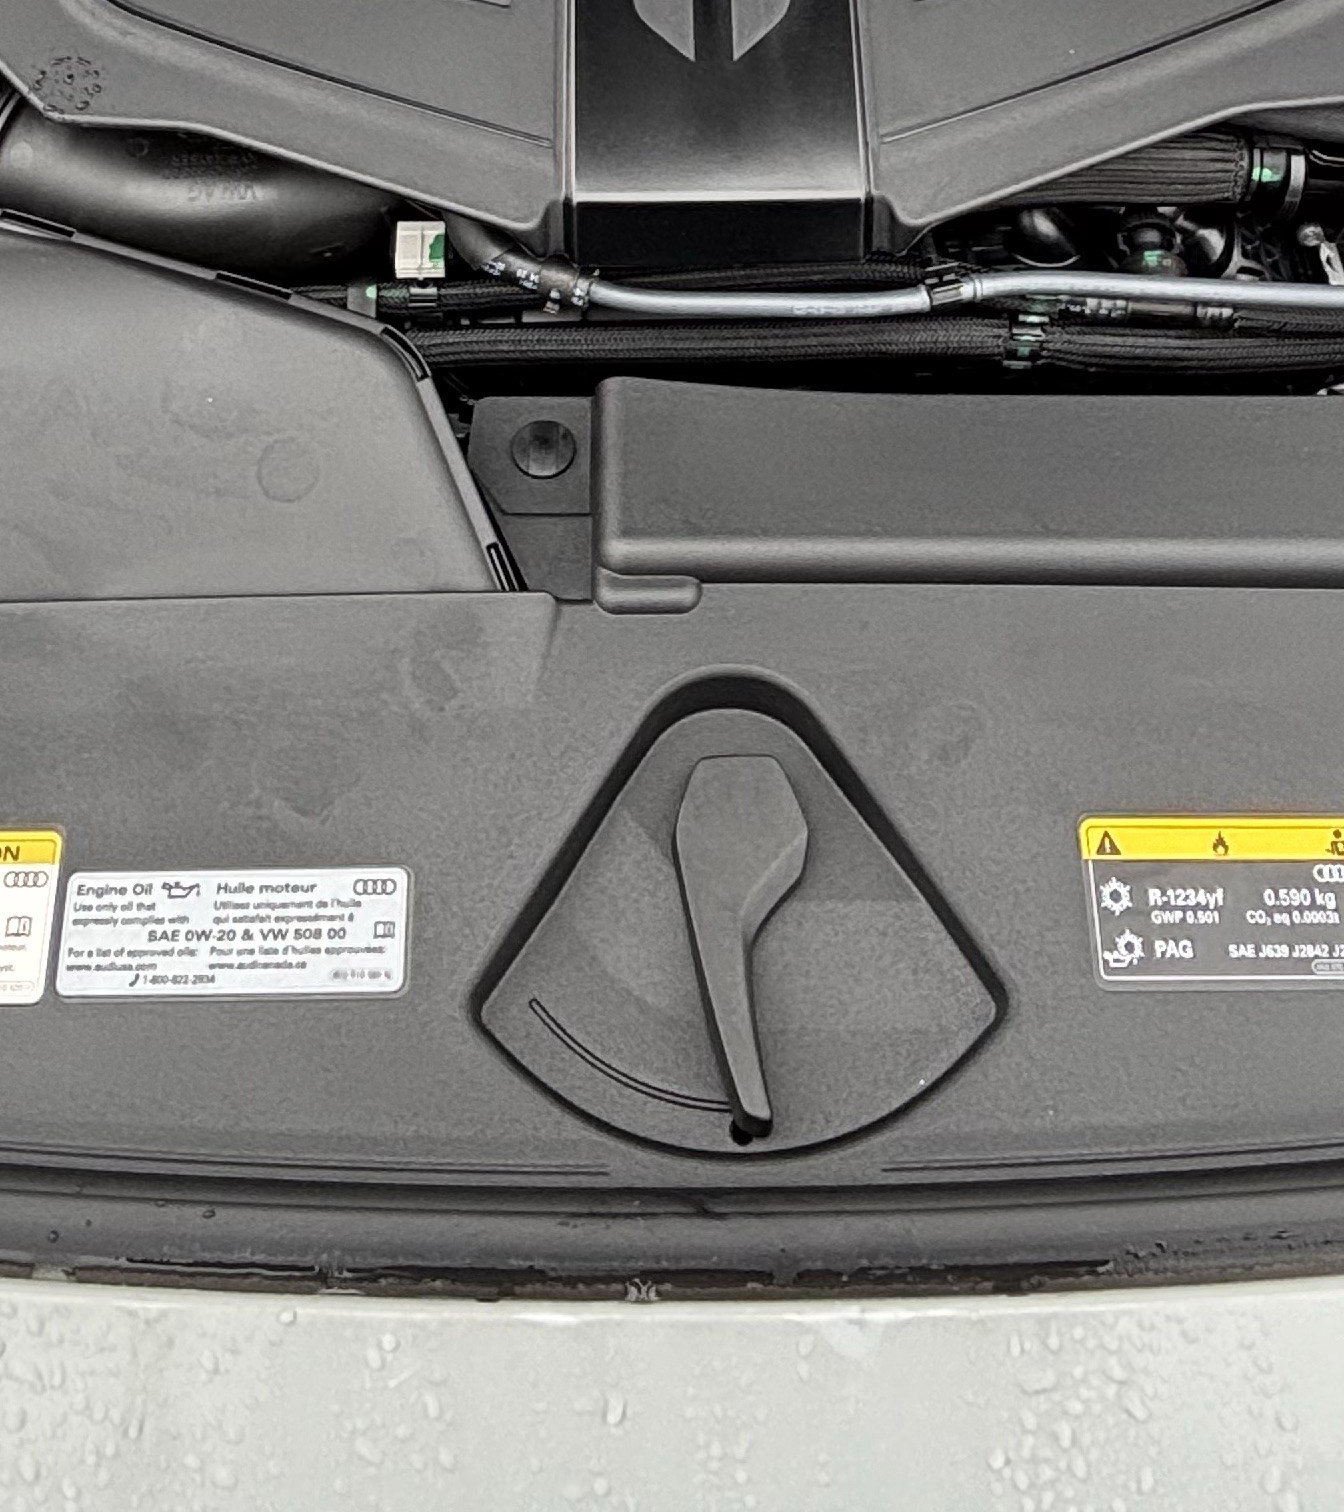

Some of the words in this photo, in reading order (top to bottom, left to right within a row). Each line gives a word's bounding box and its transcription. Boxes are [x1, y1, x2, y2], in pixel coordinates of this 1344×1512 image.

[77, 884, 127, 898] Engine
[132, 883, 153, 895] Oil
[216, 882, 255, 894] Huile
[259, 883, 317, 894] moteur
[1148, 888, 1224, 909] R-1234yf
[1263, 888, 1312, 906] 0.590
[1315, 888, 1337, 910] kg
[1151, 910, 1183, 924] GWP
[1186, 910, 1219, 924] 0.501
[1273, 912, 1291, 926] eq
[147, 929, 181, 942] SAE
[185, 929, 236, 941] 0W-20
[241, 929, 254, 942] &
[260, 928, 289, 942] VW
[293, 927, 321, 940] 508
[326, 927, 347, 940] 00
[1154, 939, 1194, 959] PAG
[1228, 944, 1256, 958] SAE
[1259, 944, 1289, 958] J639
[1292, 944, 1330, 958] J2842
